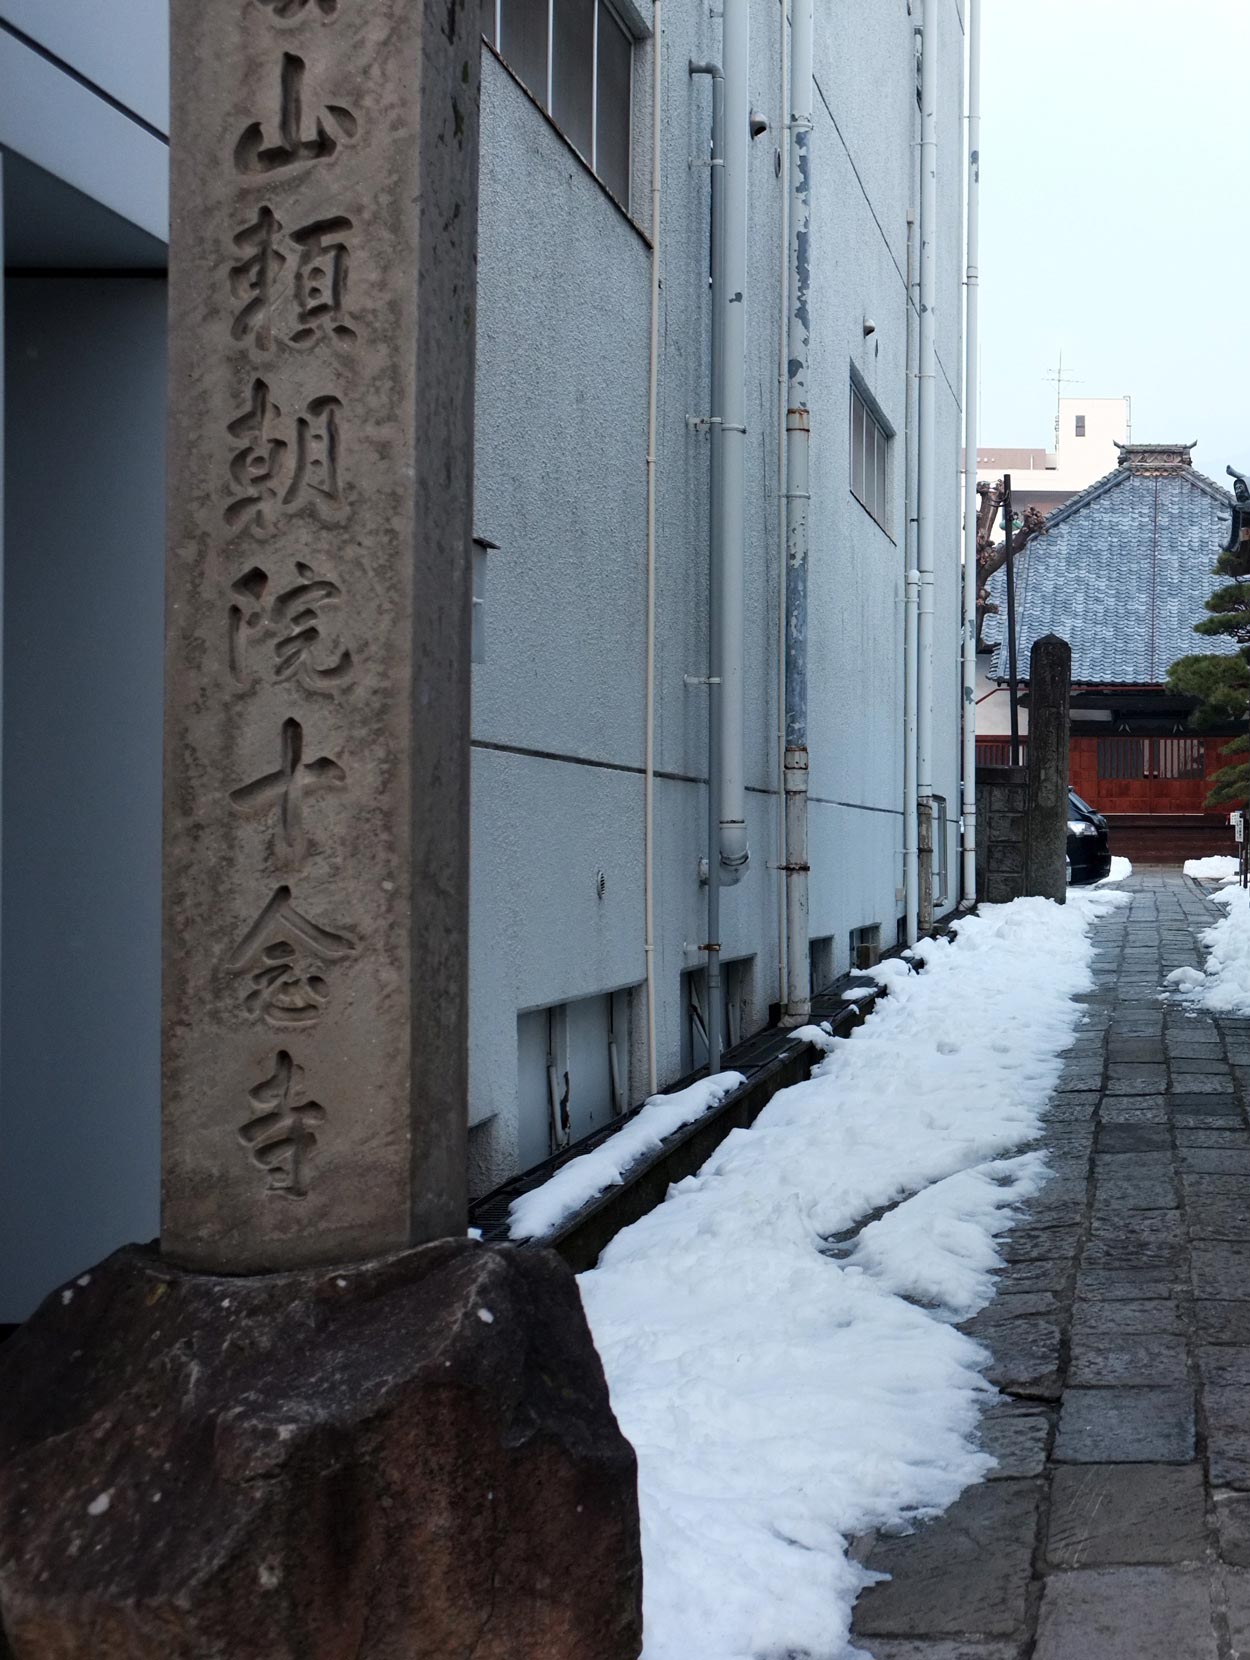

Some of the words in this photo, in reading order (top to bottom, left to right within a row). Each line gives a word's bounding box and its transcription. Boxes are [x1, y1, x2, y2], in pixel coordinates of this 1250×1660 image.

[222, 0, 358, 1200] 山頼朝院十念寺
